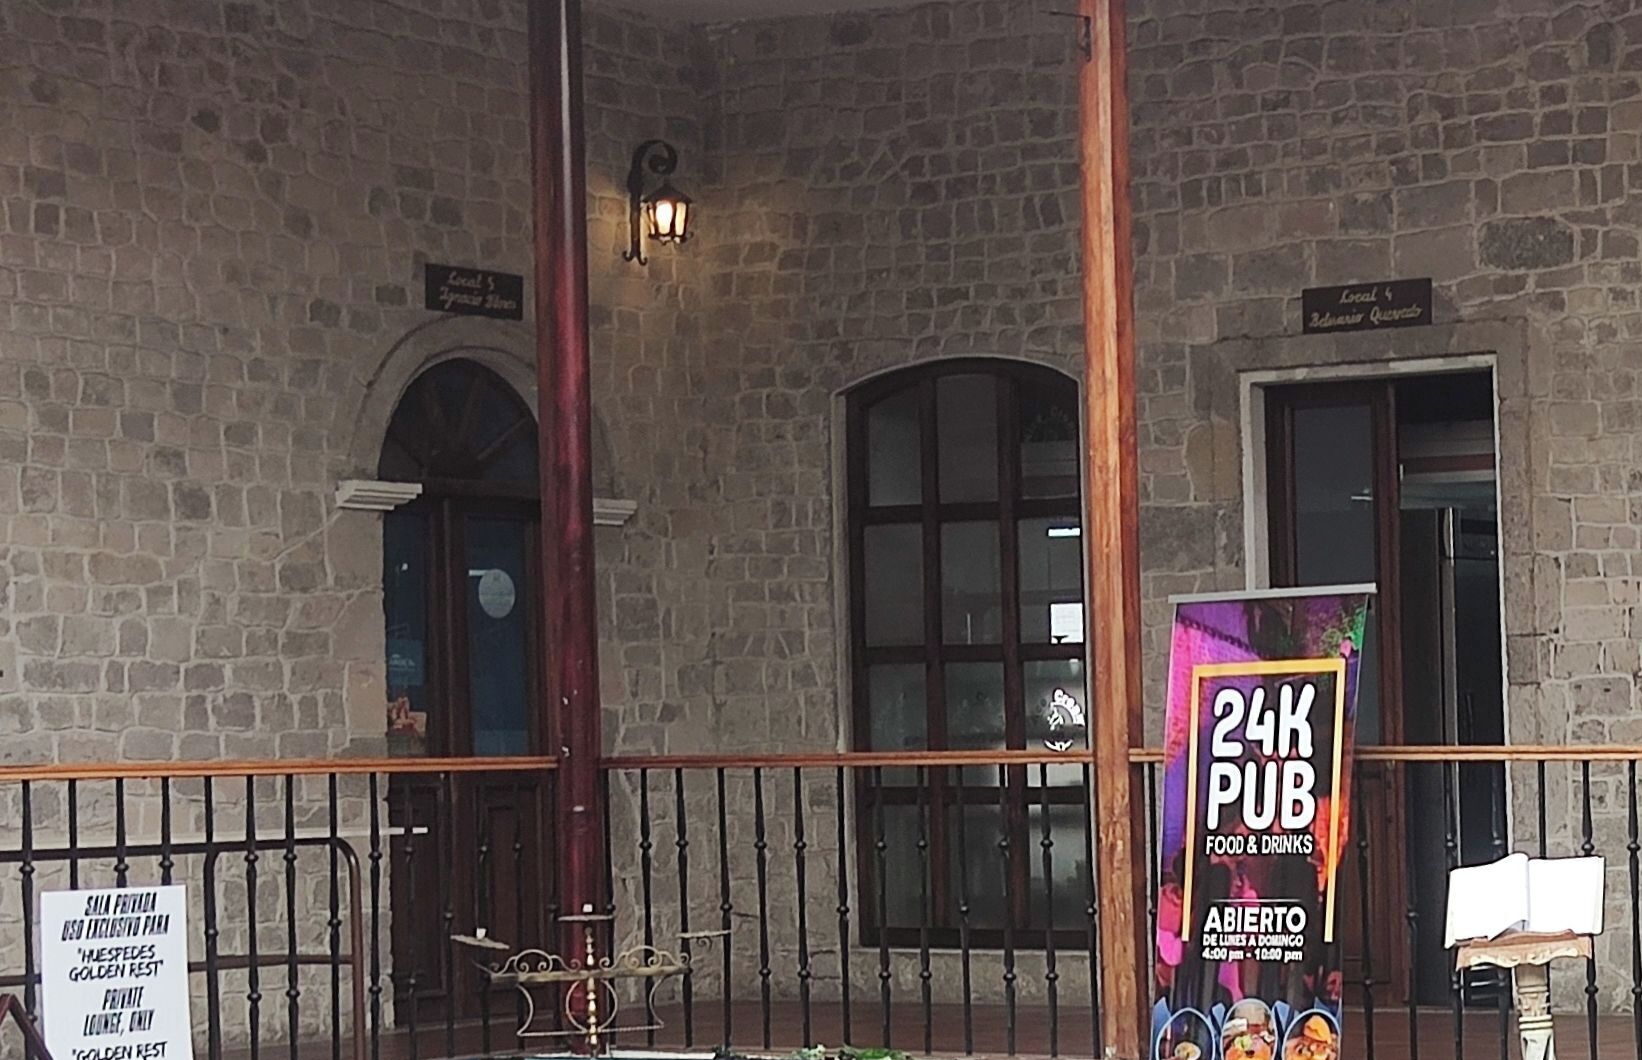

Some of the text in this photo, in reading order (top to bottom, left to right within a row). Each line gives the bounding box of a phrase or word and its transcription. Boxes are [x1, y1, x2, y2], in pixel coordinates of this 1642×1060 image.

[1340, 286, 1393, 304] Local 4
[1212, 684, 1316, 759] 24K
[1206, 760, 1316, 831] PUB
[1205, 834, 1314, 855] FOOD & DRINKS
[85, 892, 158, 916] SALA PRIVADA
[61, 914, 170, 942] USO EXCLUSIVO PARA
[1203, 906, 1307, 934] ABIERTO
[1202, 934, 1304, 947] DE LUNES A DOMINGO
[1202, 947, 1228, 959] 4:00
[1228, 950, 1244, 962] pm
[1284, 950, 1303, 963] pm
[68, 963, 126, 983] GOLDEN
[102, 986, 145, 1011] PRIVATE
[83, 1009, 155, 1037] LOUNGE, ONLY
[136, 1040, 168, 1060] REST
